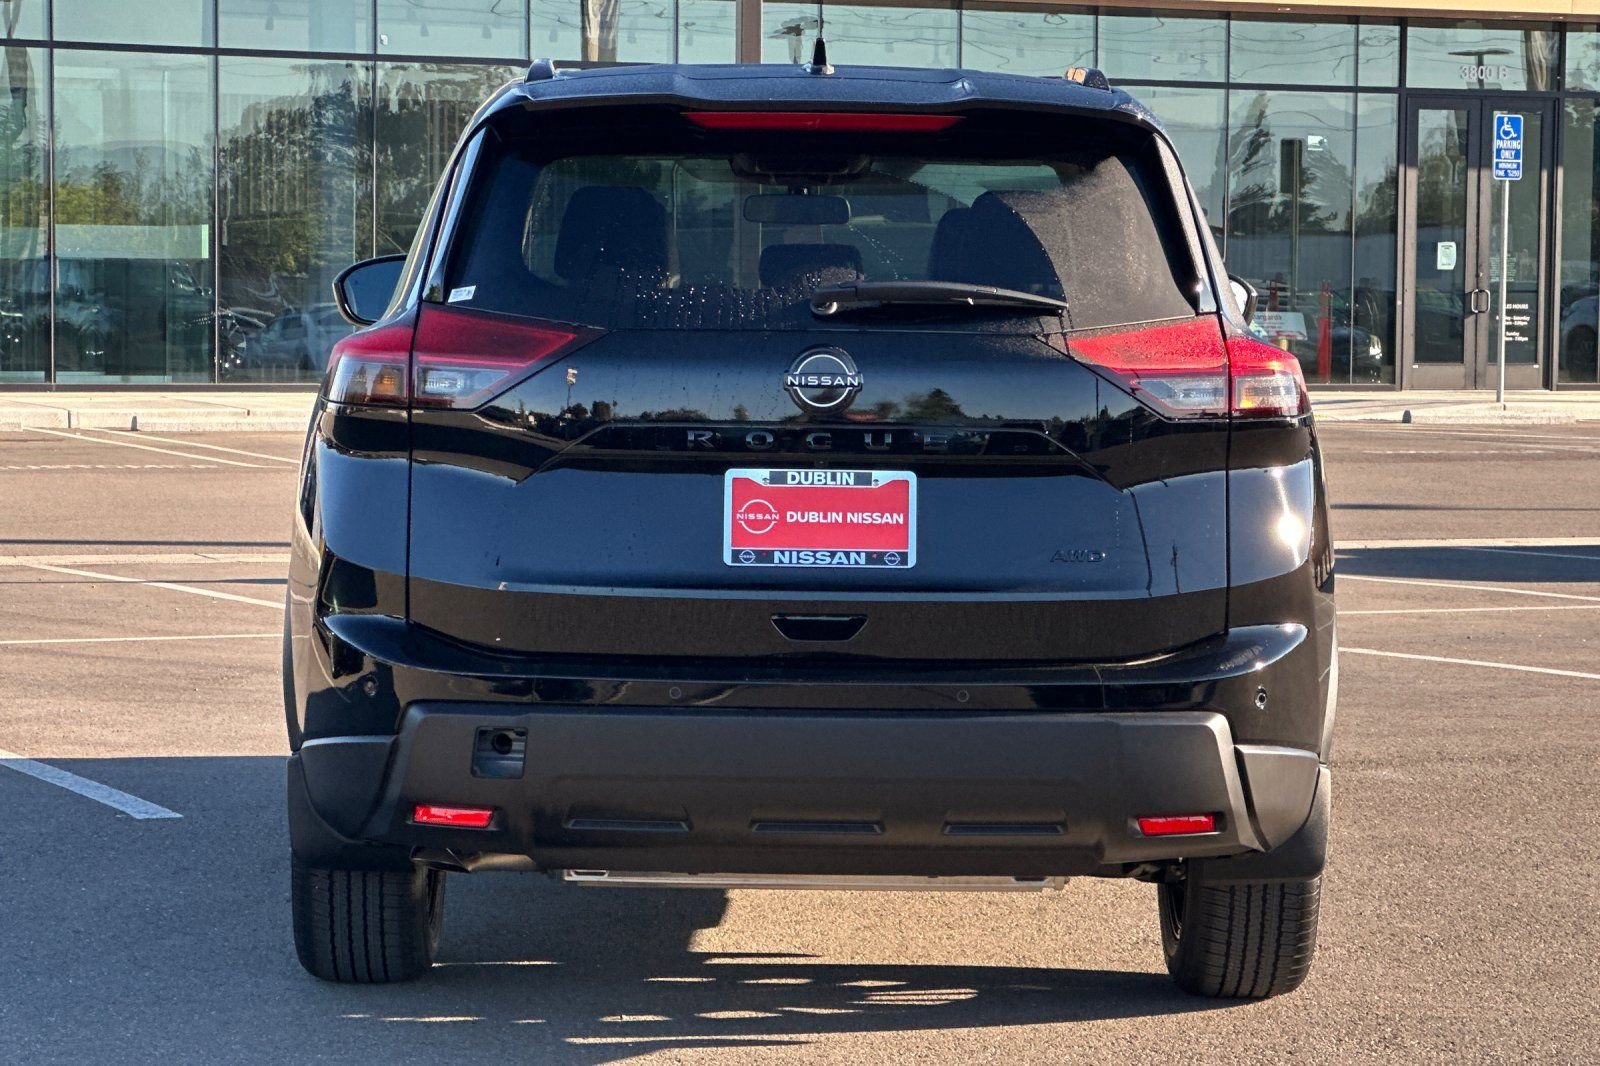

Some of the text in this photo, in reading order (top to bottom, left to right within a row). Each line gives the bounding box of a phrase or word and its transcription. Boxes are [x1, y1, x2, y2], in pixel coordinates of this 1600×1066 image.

[1461, 65, 1493, 80] 3800
[1496, 140, 1521, 149] PARKING
[1501, 149, 1516, 159] ONLY
[1498, 162, 1518, 170] MINIMUM
[1495, 169, 1505, 177] FINE
[787, 375, 859, 387] NISSAN
[687, 430, 950, 450] ROGUE
[786, 471, 855, 486] DUBLIN
[736, 513, 780, 521] NISSAN
[786, 511, 904, 525] DUBLIN NISSAN
[773, 550, 866, 565] NISSAN
[1049, 549, 1107, 563] AWD
